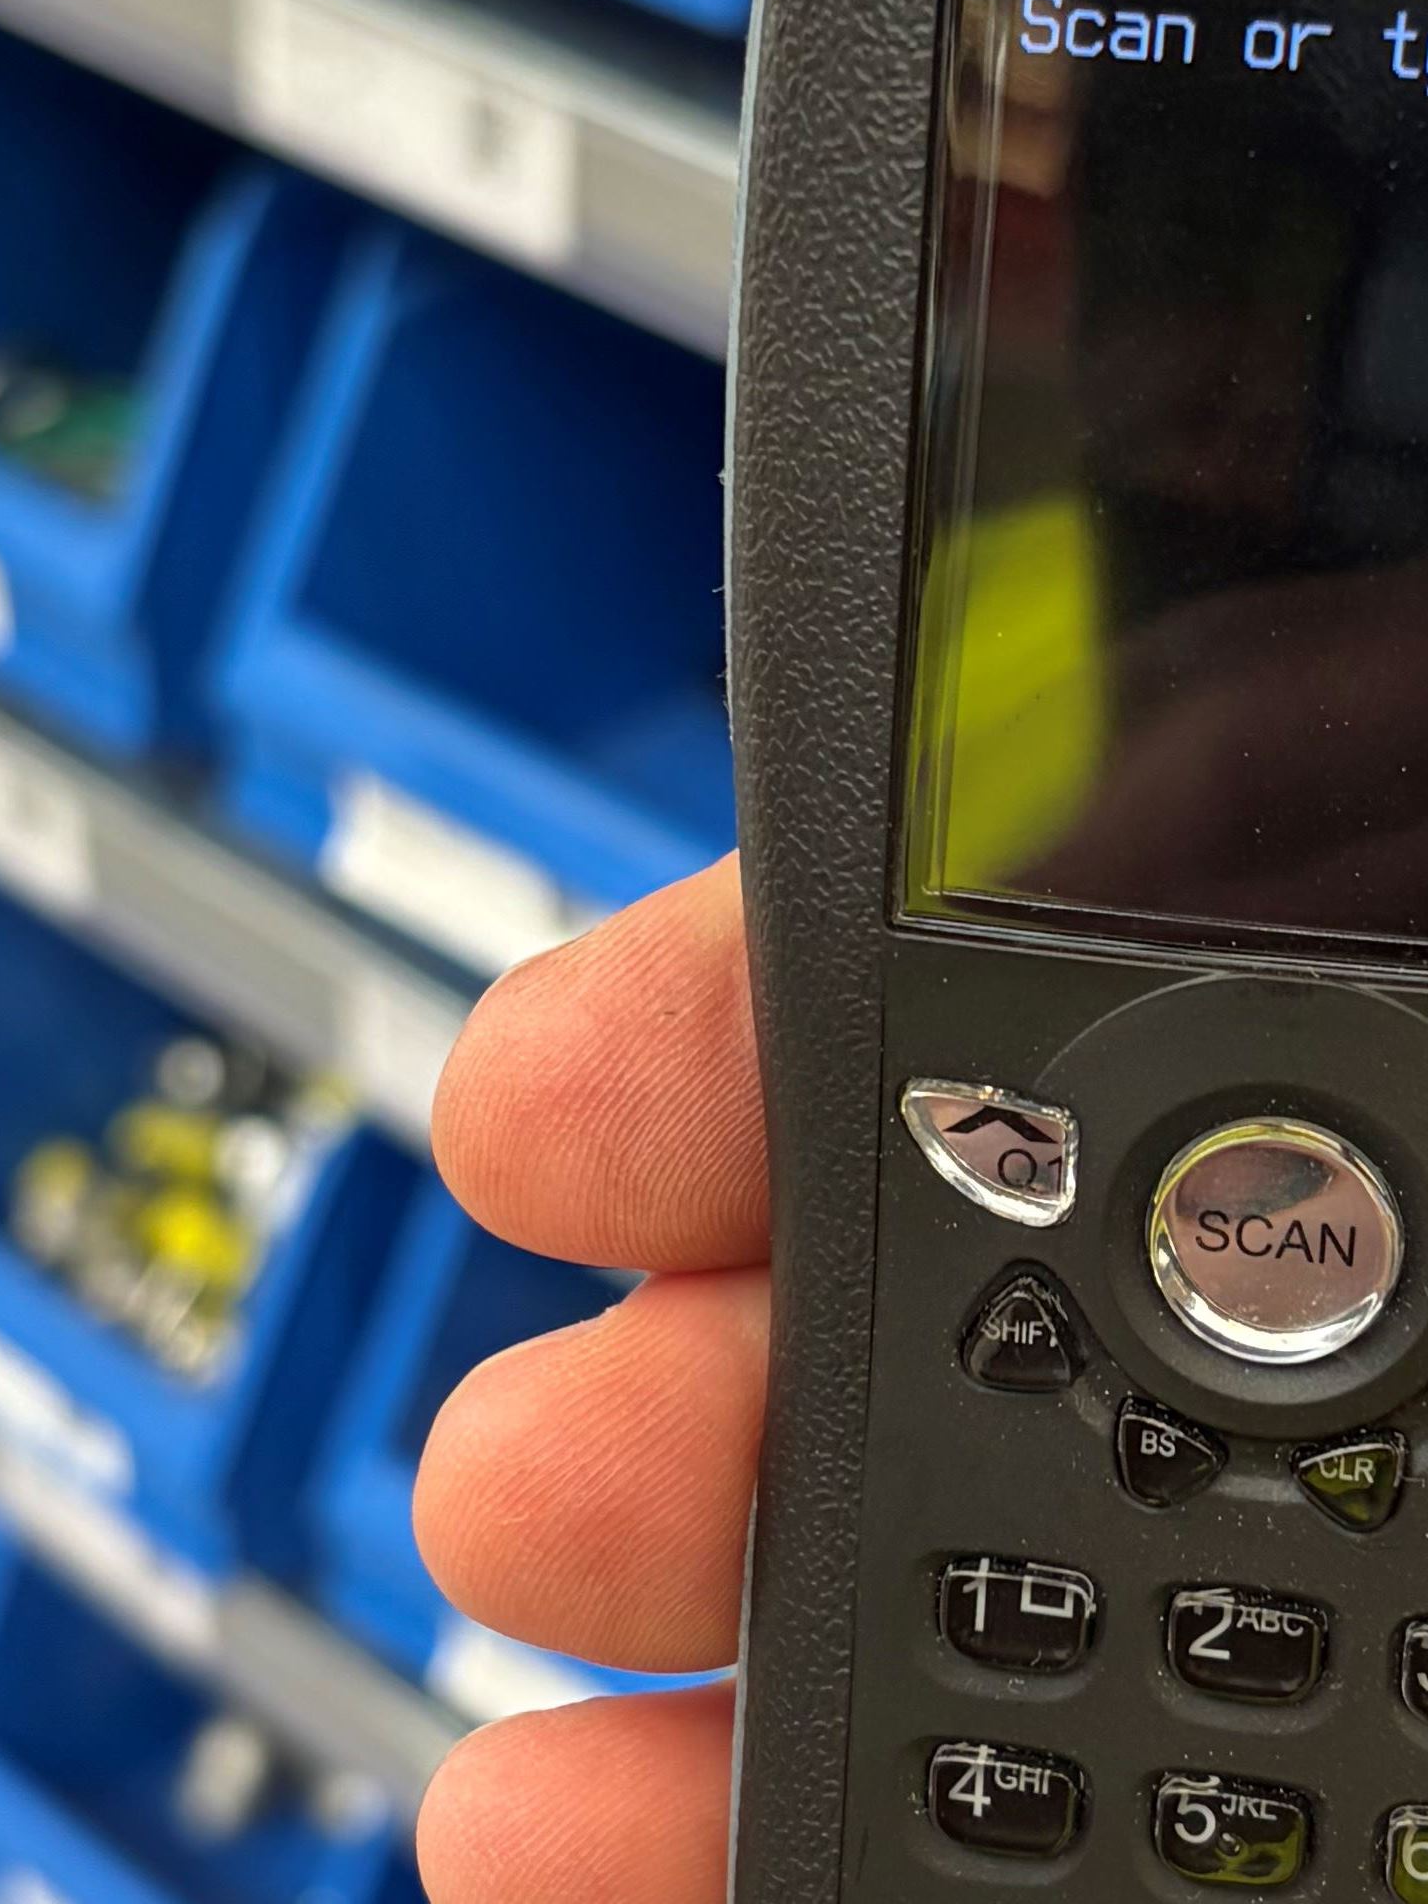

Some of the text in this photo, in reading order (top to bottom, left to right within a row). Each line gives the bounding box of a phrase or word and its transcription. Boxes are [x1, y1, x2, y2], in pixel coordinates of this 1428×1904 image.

[1242, 18, 1332, 74] or
[997, 1148, 1063, 1194] Q1
[1195, 1210, 1357, 1268] SCAN
[1140, 1429, 1177, 1458] BS
[1319, 1456, 1376, 1484] CLR
[962, 1557, 990, 1633] 1
[1184, 1594, 1235, 1662] 2
[947, 1744, 994, 1818] 4
[1173, 1787, 1218, 1845] 5
